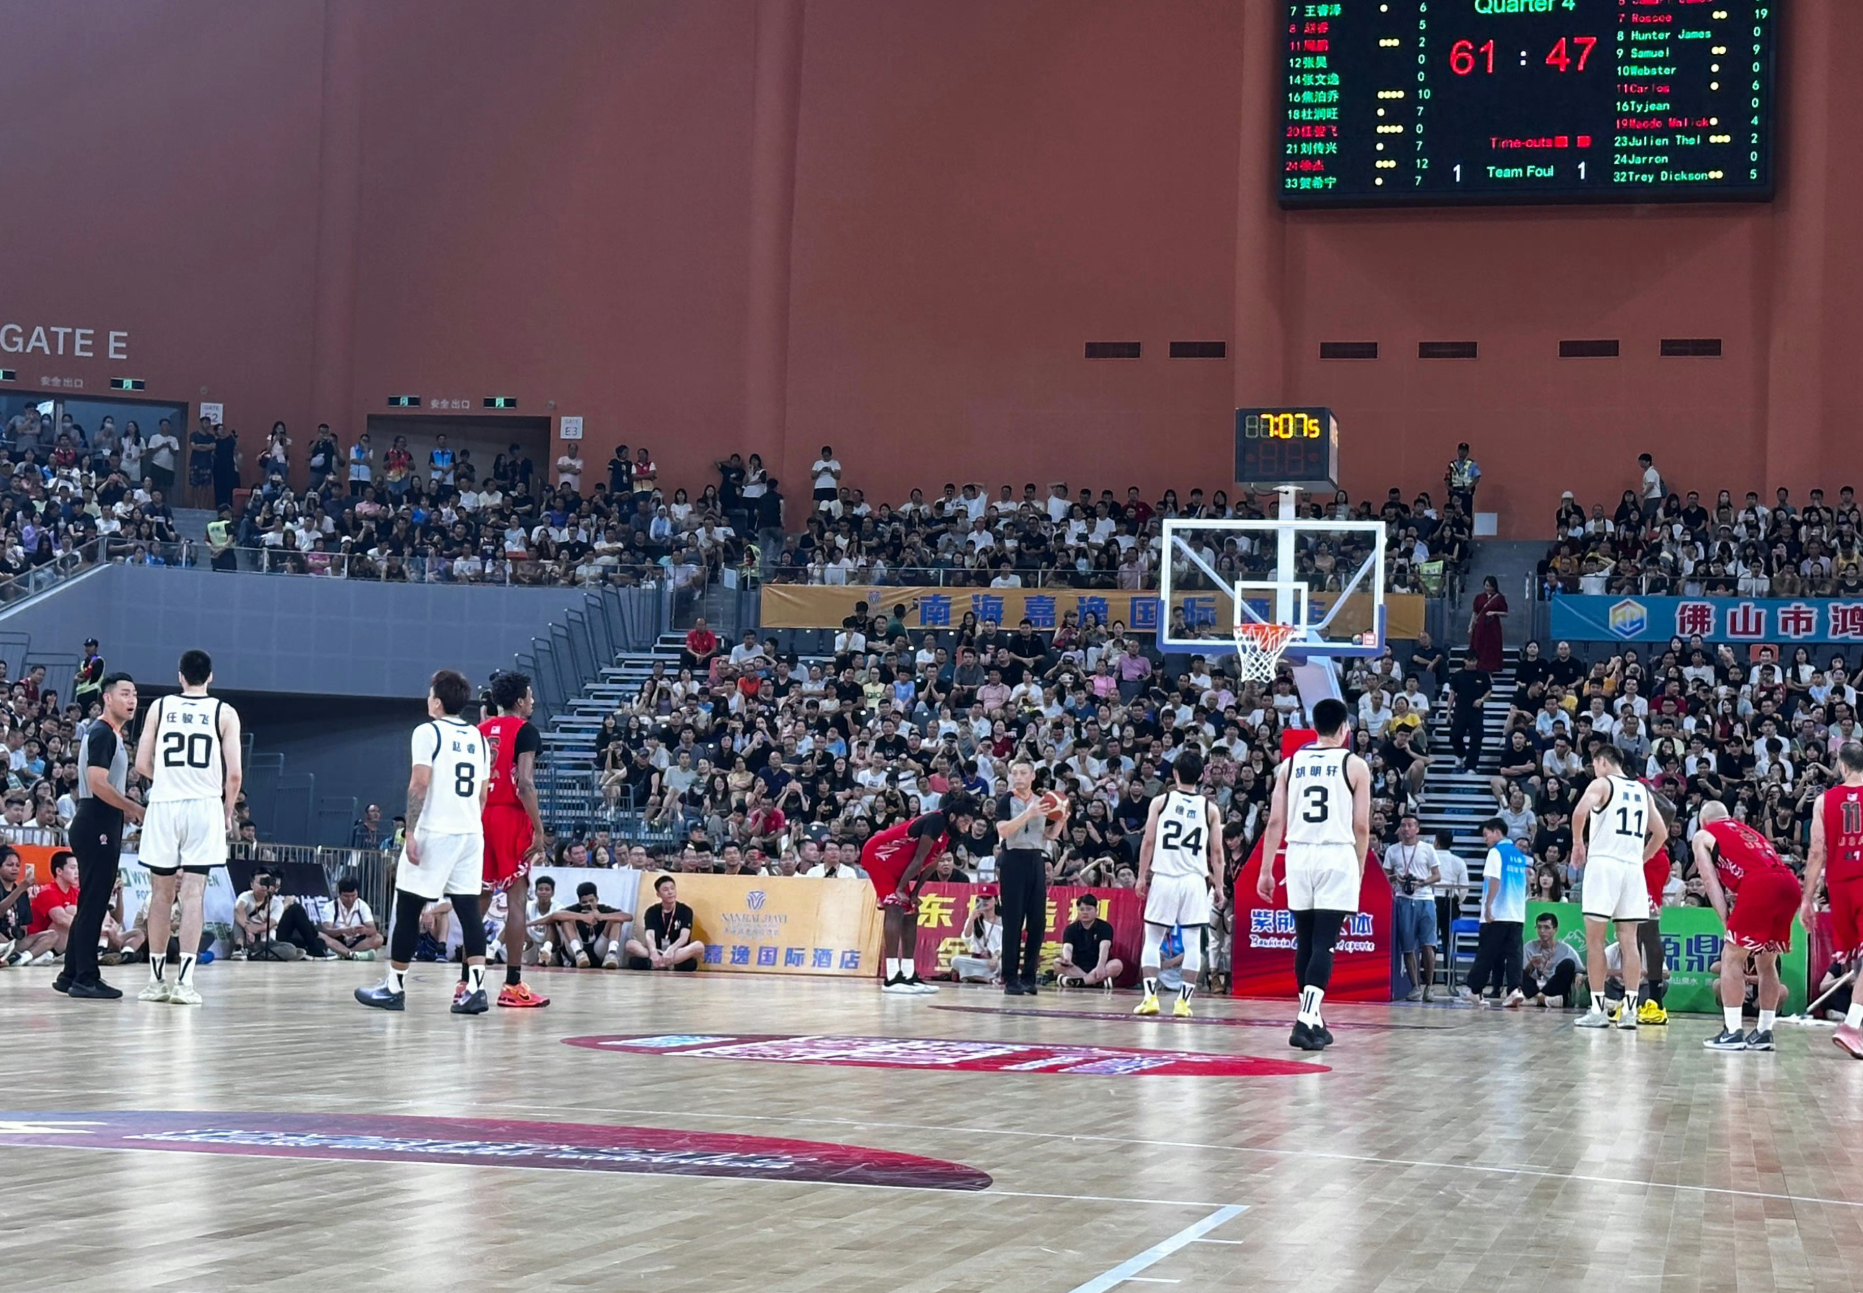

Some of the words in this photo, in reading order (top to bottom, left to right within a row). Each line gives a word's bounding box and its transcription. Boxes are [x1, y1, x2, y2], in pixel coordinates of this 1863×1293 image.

[1290, 6, 1297, 17] 7
[1420, 2, 1427, 13] 6
[1475, 0, 1554, 14] Quarter
[1618, 13, 1626, 23] 7
[1755, 8, 1768, 19] 19
[1419, 20, 1426, 30] 5
[1617, 30, 1624, 41] 8
[1631, 30, 1671, 41] Hunter
[1677, 28, 1712, 39] James
[1753, 26, 1760, 37] 0
[1290, 41, 1300, 51] 11
[1419, 37, 1425, 47] 2
[1449, 39, 1495, 75] 61
[1545, 36, 1597, 72] 47
[1616, 48, 1624, 59] 9
[1631, 47, 1669, 58] Samuel
[1752, 44, 1760, 55] 9
[1289, 57, 1302, 68] 12
[1418, 54, 1425, 64] 0
[1752, 62, 1760, 72] 0
[1289, 75, 1301, 85] 14
[1417, 71, 1425, 81] 0
[1752, 80, 1759, 90] 6
[1288, 92, 1301, 103] 16
[1418, 89, 1430, 99] 10
[1751, 97, 1759, 108] 0
[1288, 109, 1300, 120] 18
[1416, 106, 1424, 116] 7
[1751, 115, 1758, 125] 4
[1286, 126, 1300, 137] 20
[1415, 124, 1423, 134] 0
[1750, 133, 1758, 143] 2
[1286, 143, 1298, 154] 21
[1300, 141, 1338, 155] 刘传兴
[1416, 141, 1423, 151] 7
[1750, 151, 1757, 161] 0
[1285, 161, 1298, 171] 24
[1416, 158, 1428, 169] 12
[1453, 164, 1460, 182] 1
[1486, 166, 1523, 178] Team
[1527, 165, 1554, 177] Foul
[1577, 161, 1585, 180] 1
[1284, 178, 1298, 189] 33
[1415, 175, 1422, 186] 7
[1661, 170, 1708, 181] Dickson
[1750, 169, 1757, 179] 5
[0, 323, 94, 357] GATE
[108, 331, 128, 359] E
[41, 376, 84, 389] 安全出口
[430, 398, 471, 410] 安全出口
[565, 426, 578, 436] E3
[163, 732, 213, 768] 20
[1295, 765, 1338, 779] 胡明轩
[455, 762, 475, 798] 8
[1303, 785, 1328, 823] 3
[1616, 806, 1643, 839] 11
[1840, 801, 1862, 834] 11
[1162, 820, 1202, 856] 24
[703, 944, 861, 970] 嘉逸国际酒店
